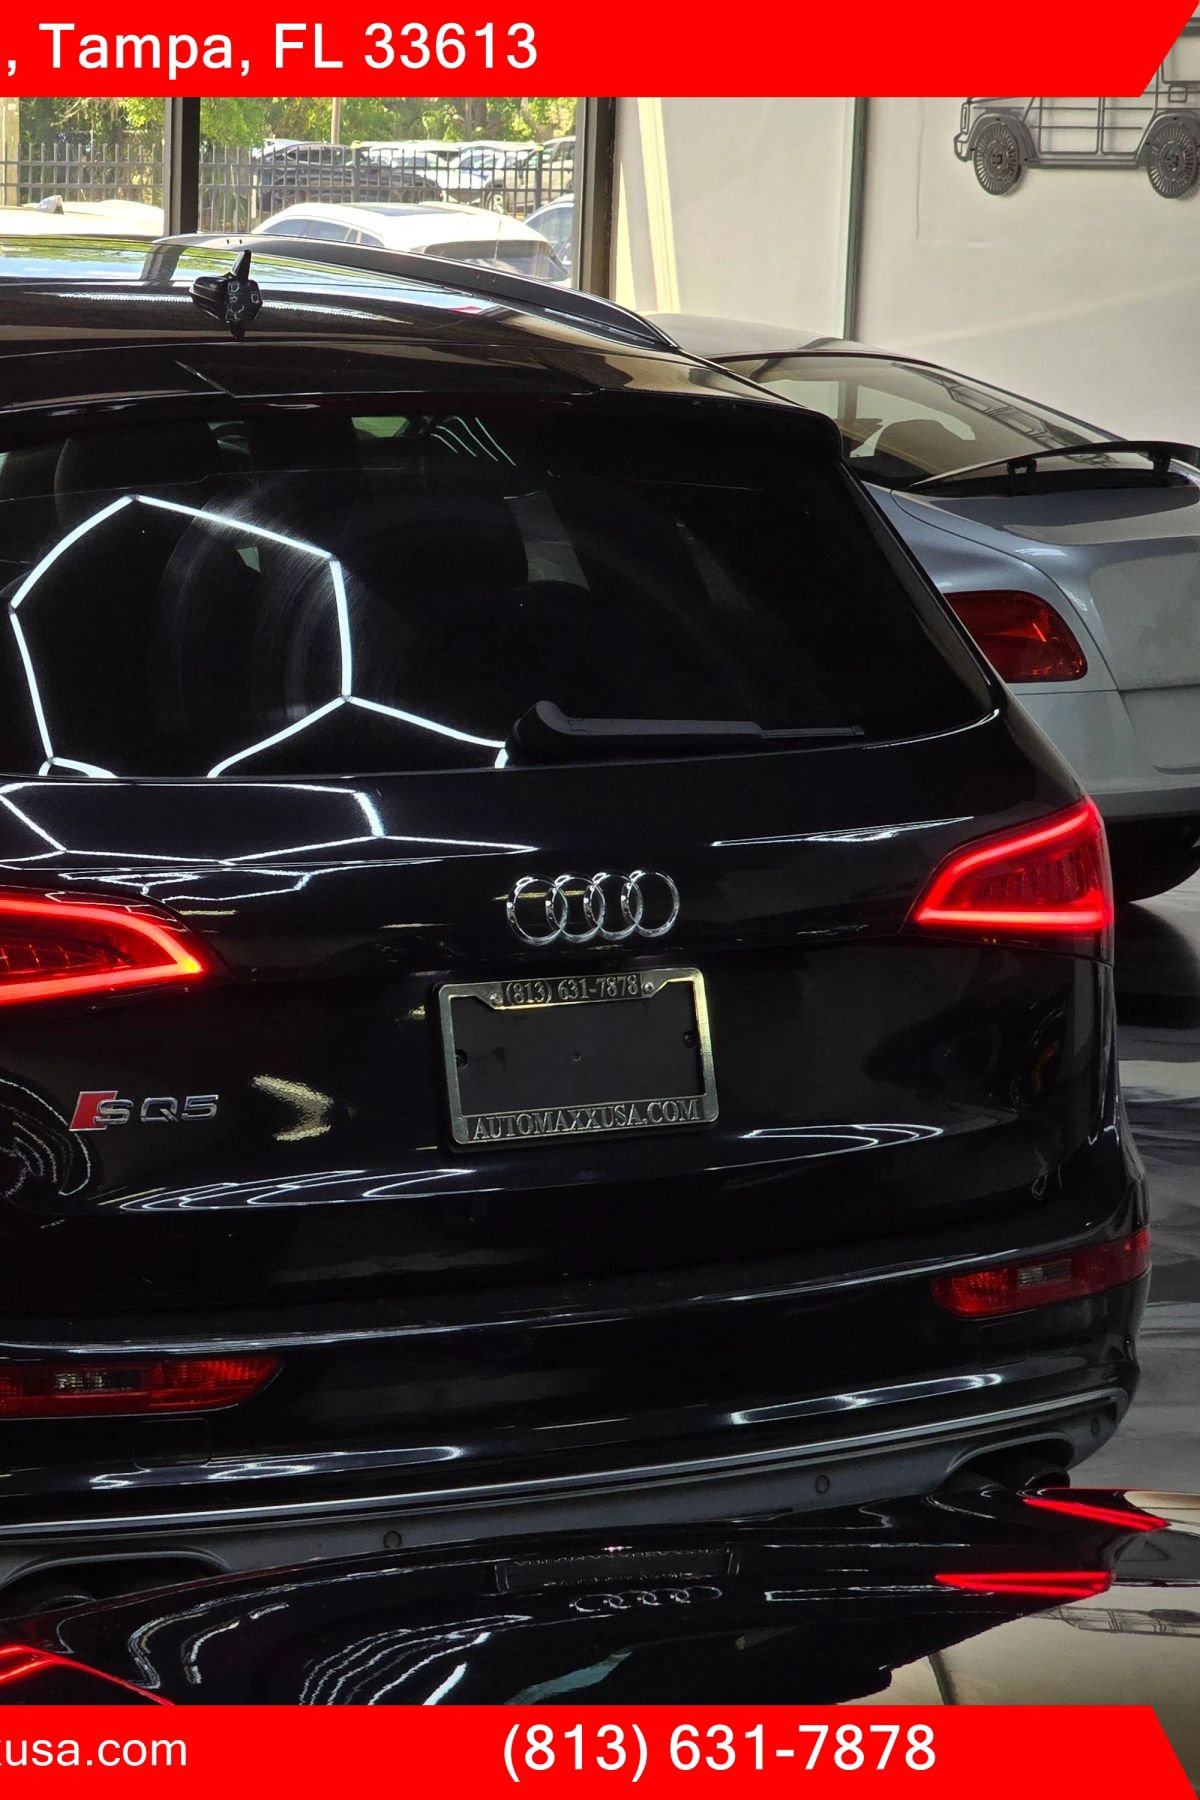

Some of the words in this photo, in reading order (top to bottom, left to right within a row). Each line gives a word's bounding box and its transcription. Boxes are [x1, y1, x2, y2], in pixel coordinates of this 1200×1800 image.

[505, 979, 553, 1006] (813)
[557, 974, 640, 1000] 631-7878
[91, 1094, 220, 1126] SQ5
[472, 1100, 701, 1141] AUTOMAXXUSA.COM
